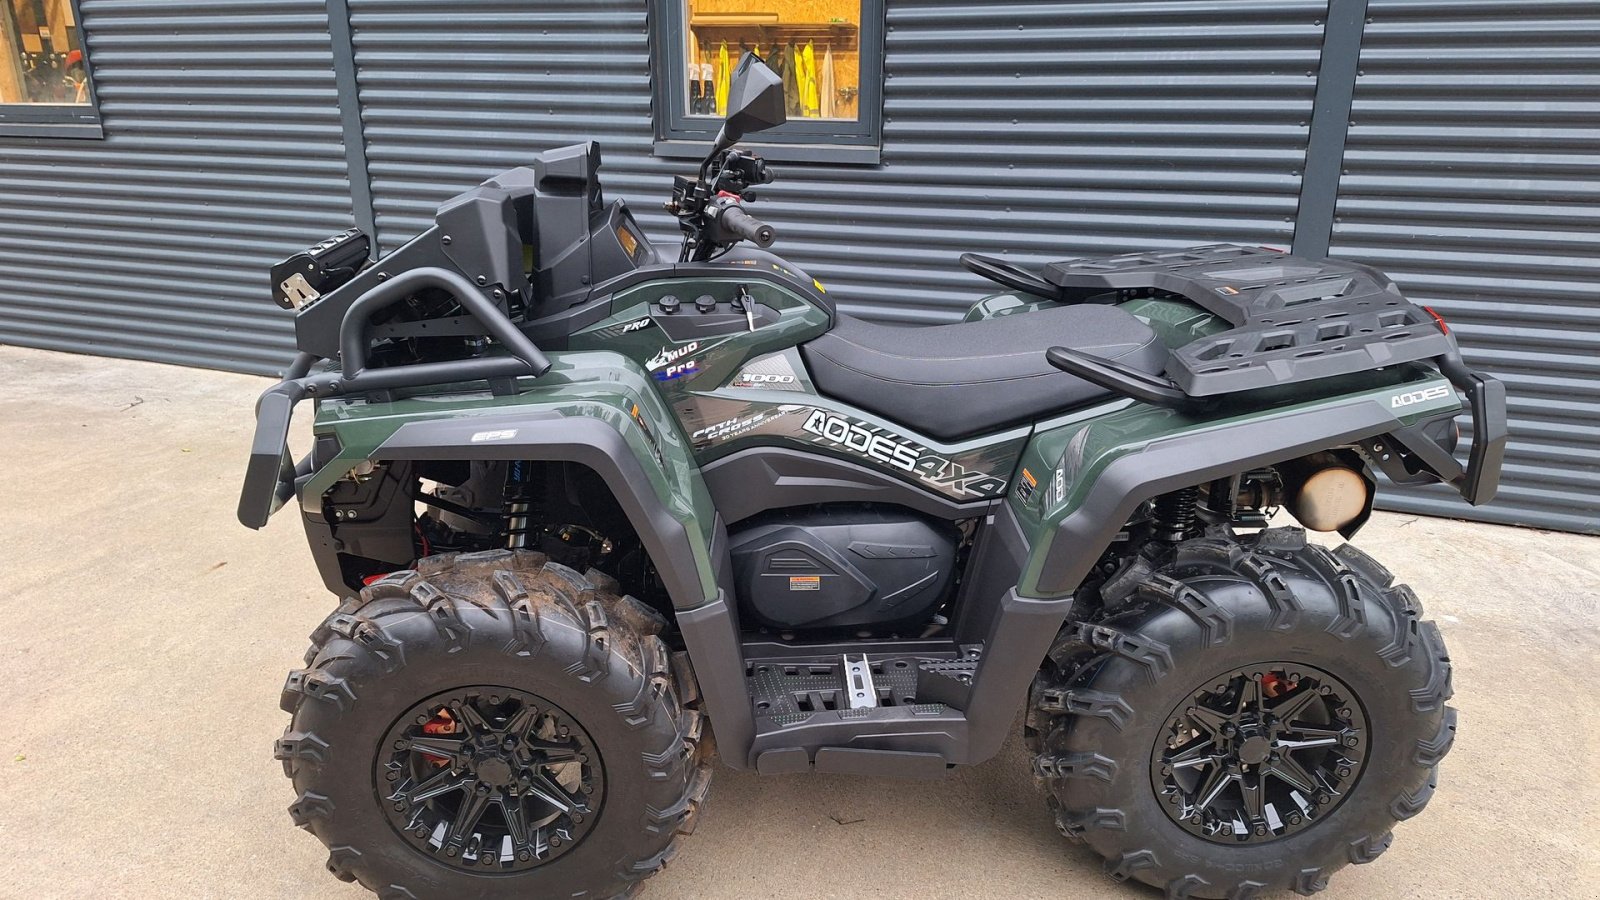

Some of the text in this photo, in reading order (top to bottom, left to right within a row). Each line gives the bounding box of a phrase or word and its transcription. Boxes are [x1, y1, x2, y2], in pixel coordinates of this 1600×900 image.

[623, 318, 651, 333] PRO
[667, 341, 698, 362] MUD
[666, 360, 695, 377] Pro
[742, 373, 795, 384] 1000
[1391, 385, 1450, 408] AODES
[470, 428, 519, 443] EPS
[692, 417, 738, 439] PATH
[707, 412, 764, 440] CROSS
[801, 408, 922, 472] AODES
[913, 454, 1007, 499] 4X4
